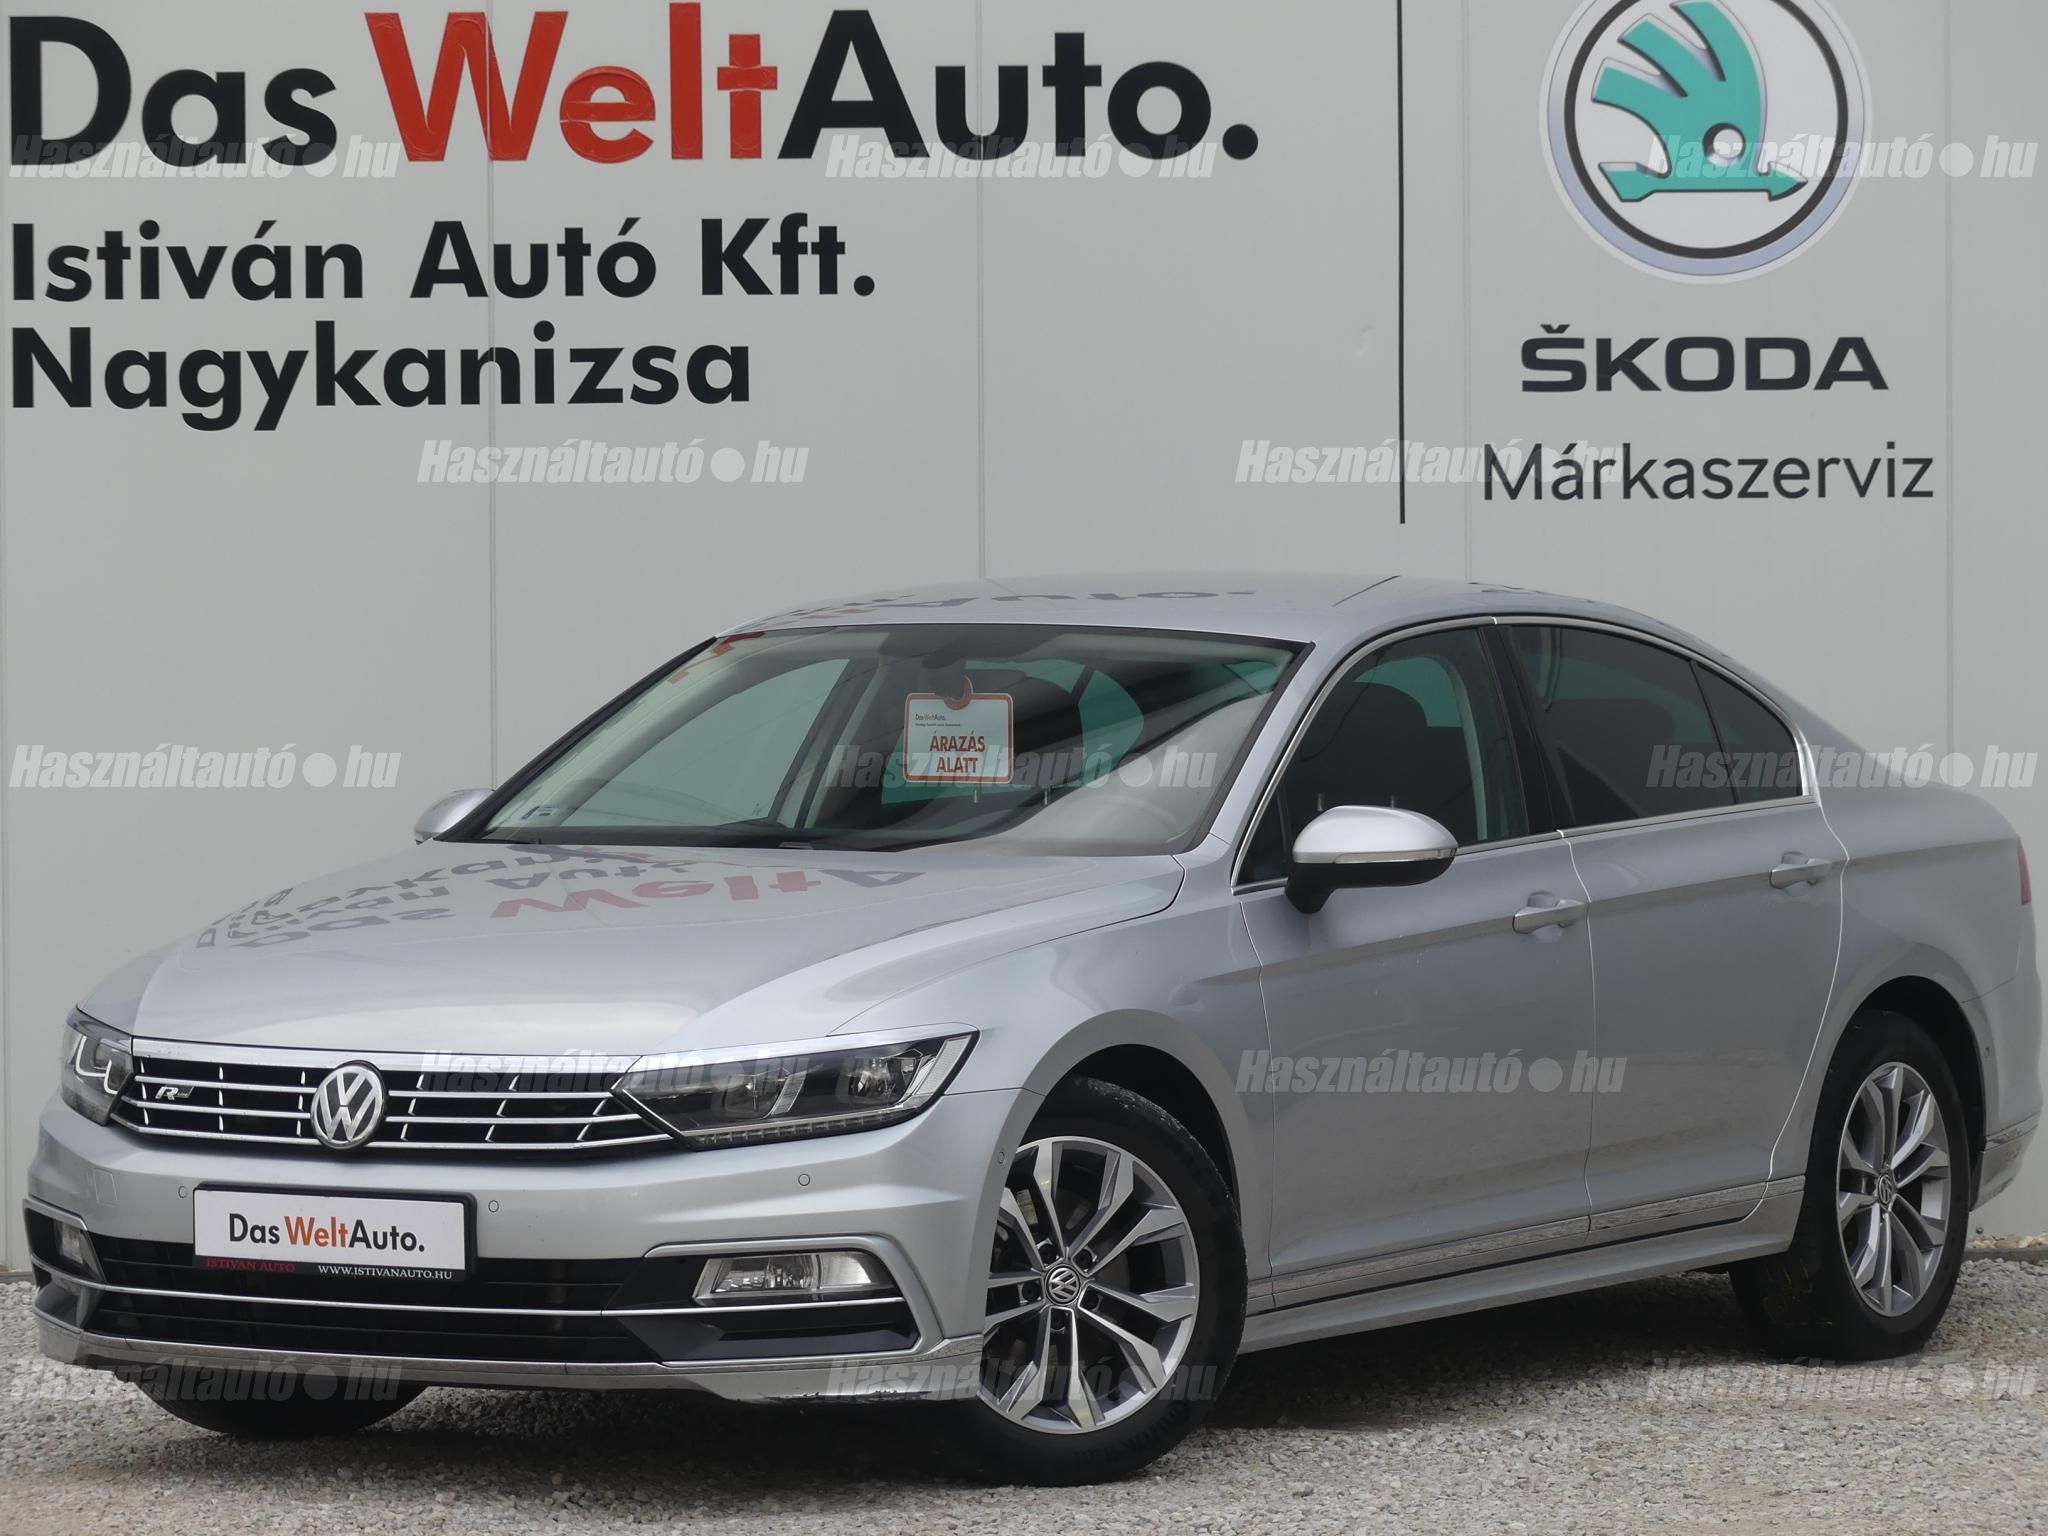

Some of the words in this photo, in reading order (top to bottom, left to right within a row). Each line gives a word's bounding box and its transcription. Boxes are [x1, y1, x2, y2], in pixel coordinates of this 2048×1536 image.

[9, 15, 338, 168] Das
[365, 2, 1259, 164] WeltAuto.
[12, 219, 363, 302] Istiván
[410, 217, 657, 299] Autó
[701, 212, 876, 297] Kft.
[12, 320, 750, 432] Nagykanizsa
[1520, 324, 1889, 393] ŠKODA
[1482, 441, 1934, 501] Márkaszerviz
[929, 730, 986, 752] ÁRAZÁS
[936, 756, 979, 773] ALATT
[229, 1212, 281, 1245] Das
[283, 1215, 426, 1252] WeltAuto.
[206, 1258, 256, 1271] ISTIVAN
[259, 1262, 296, 1273] AUTO
[317, 1265, 453, 1280] WWW.ISTIVANAUTO.HU
